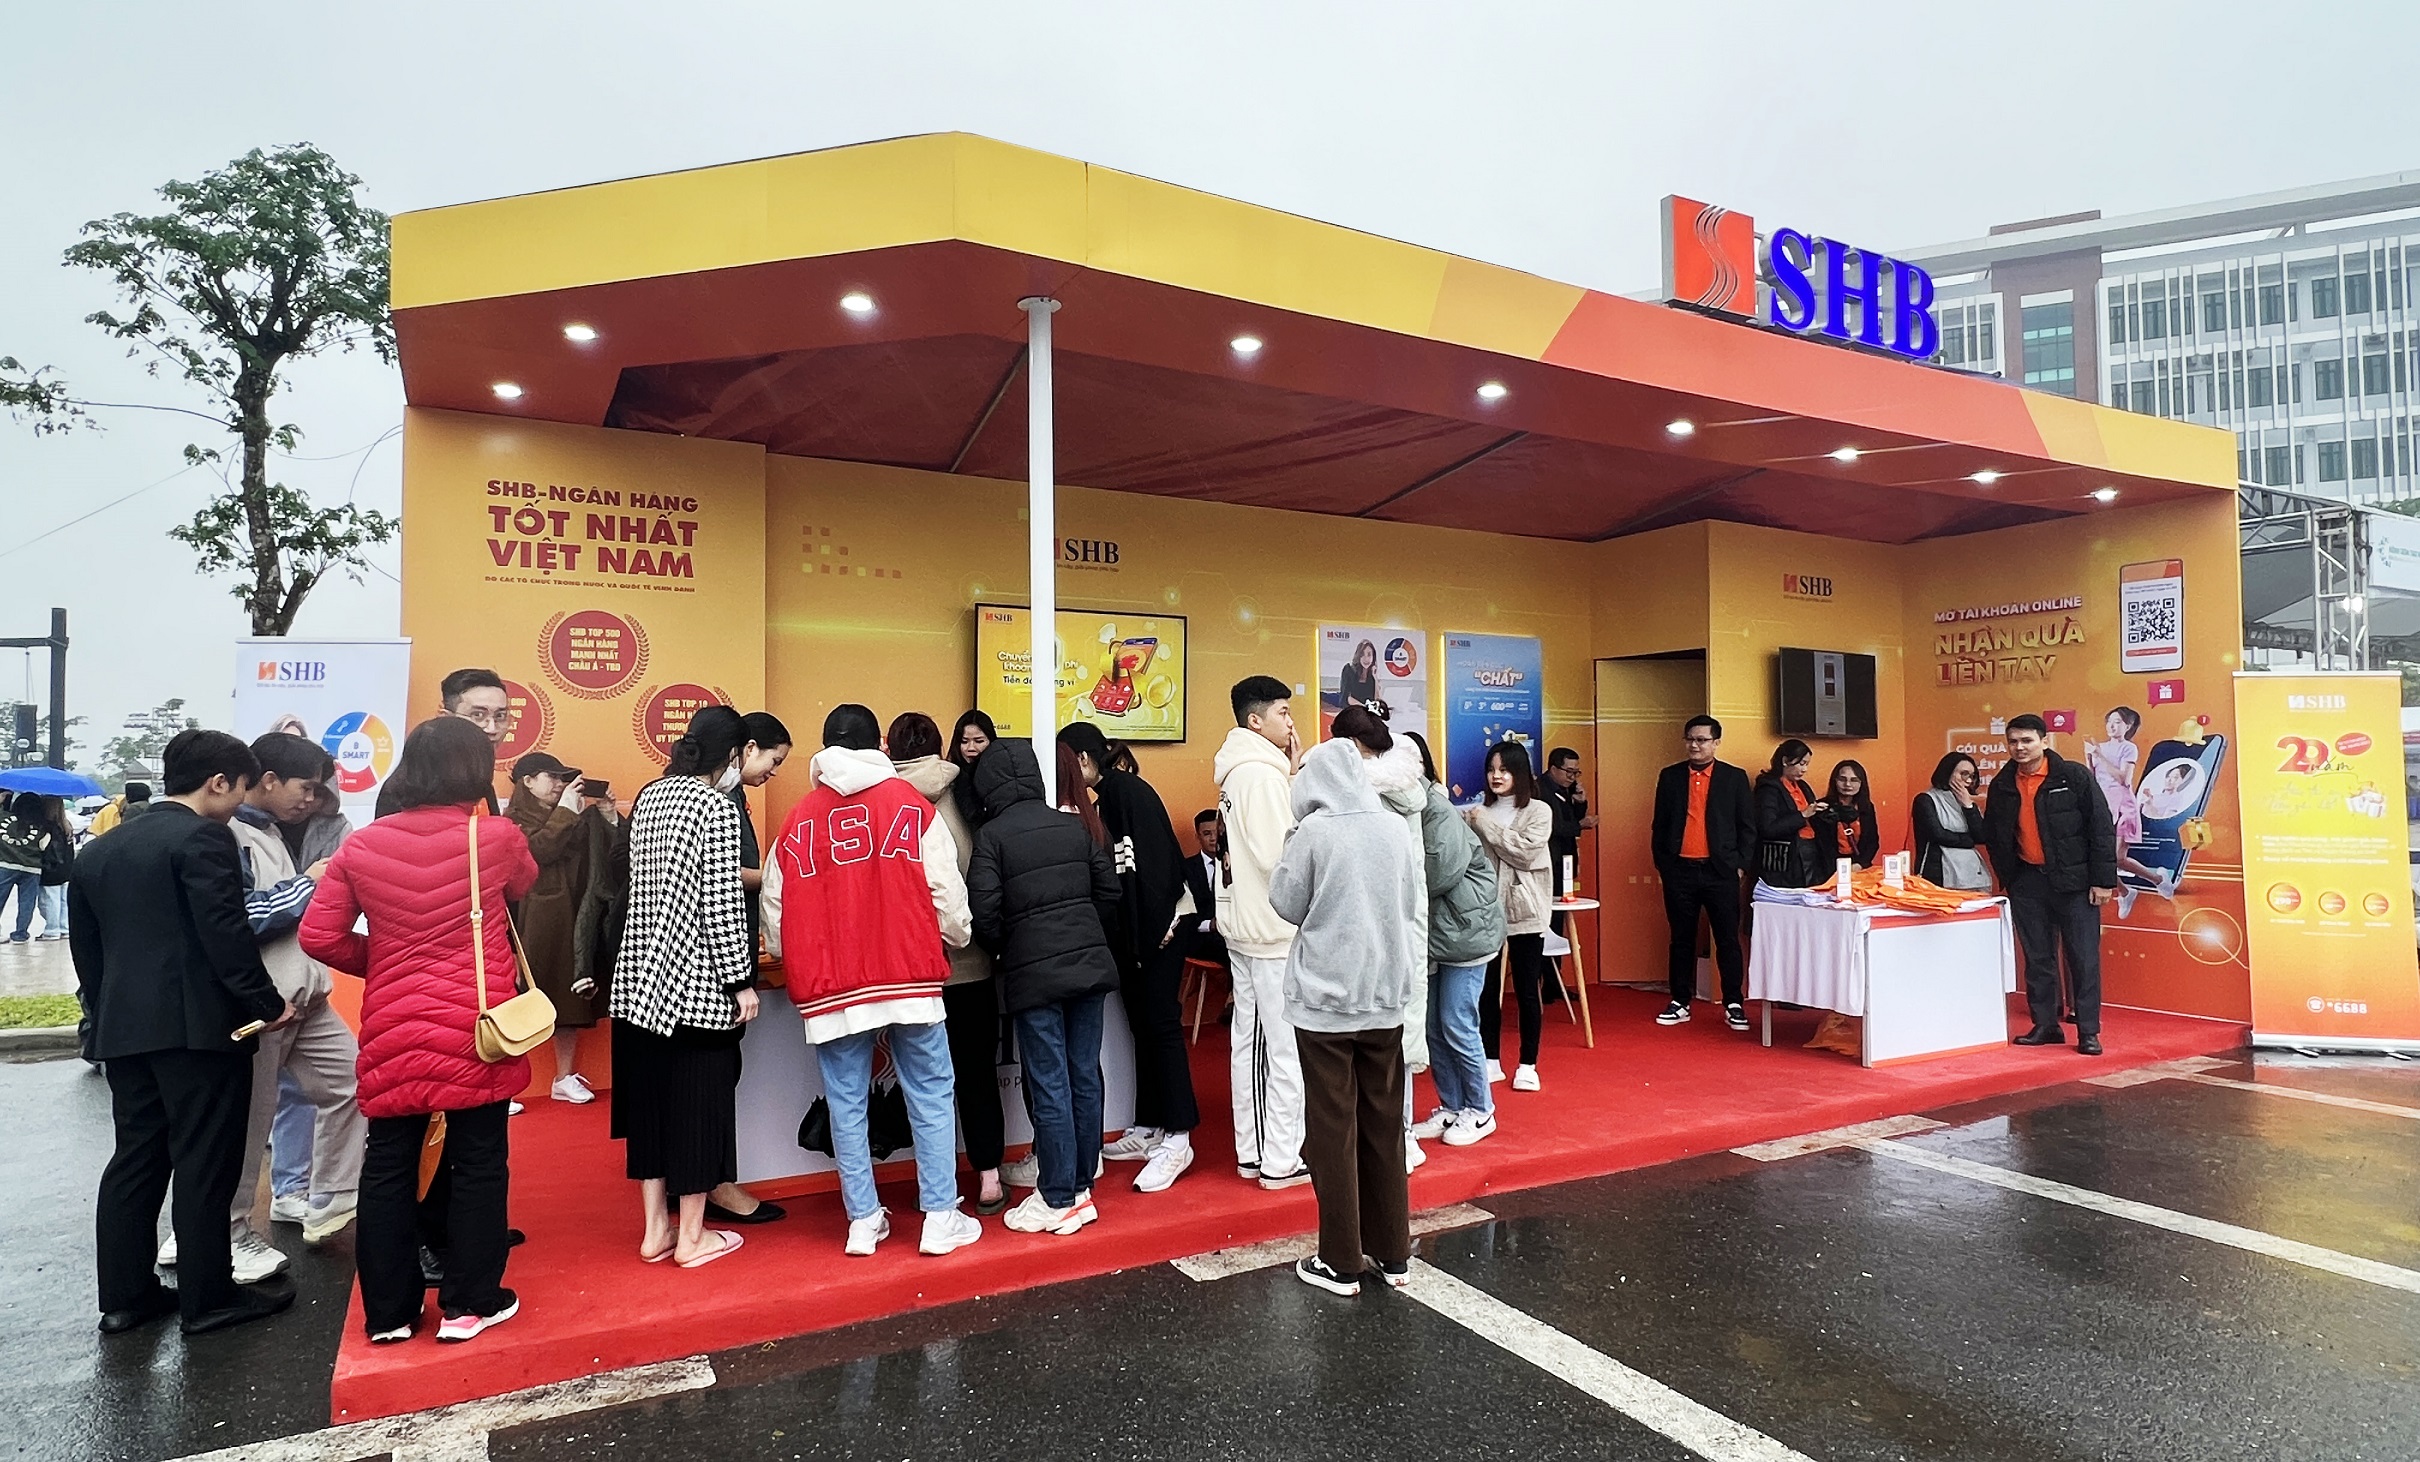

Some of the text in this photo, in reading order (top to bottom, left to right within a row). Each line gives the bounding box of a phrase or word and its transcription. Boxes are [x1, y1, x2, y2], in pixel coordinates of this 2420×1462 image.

[1763, 227, 1939, 358] SHB
[488, 500, 699, 547] TỐT NHẤT
[486, 537, 694, 578] VIỆT NAM
[1065, 538, 1119, 564] SHB
[1800, 575, 1833, 597] SHB
[2032, 596, 2082, 612] ONLINE
[588, 628, 604, 637] TOP
[2020, 616, 2086, 648] QUÀ
[279, 662, 326, 681] SHB
[1999, 655, 2057, 682] TAY
[2306, 695, 2346, 709] SHB
[342, 751, 370, 759] SMART
[1955, 742, 1977, 753] GÓI
[783, 804, 923, 878] YSA
